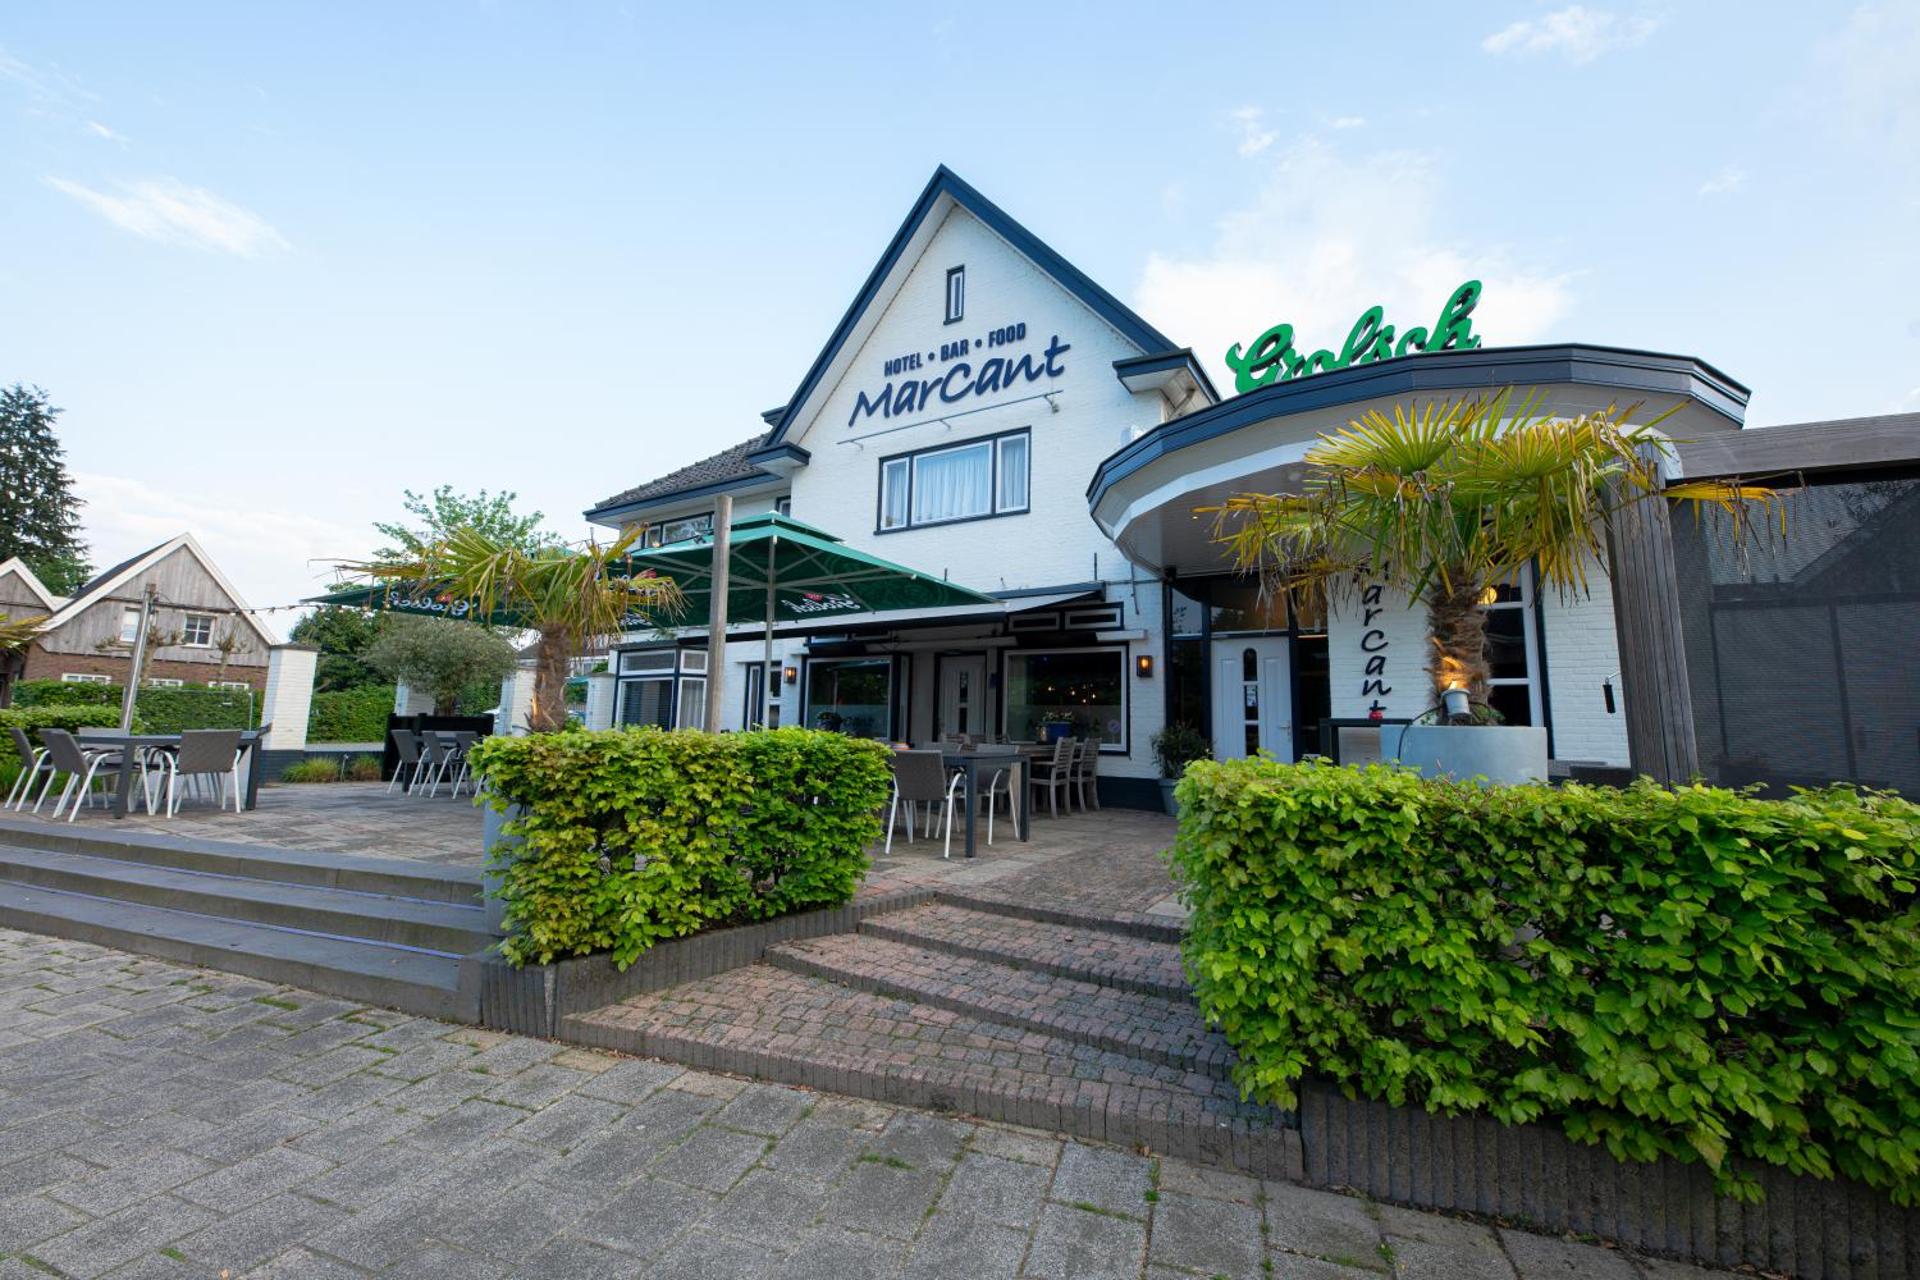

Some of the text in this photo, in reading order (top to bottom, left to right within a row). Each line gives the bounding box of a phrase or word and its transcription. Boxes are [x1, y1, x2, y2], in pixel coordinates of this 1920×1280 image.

[884, 322, 1026, 377] HOTEL BAR FOOD
[1225, 280, 1482, 395] Grolsch
